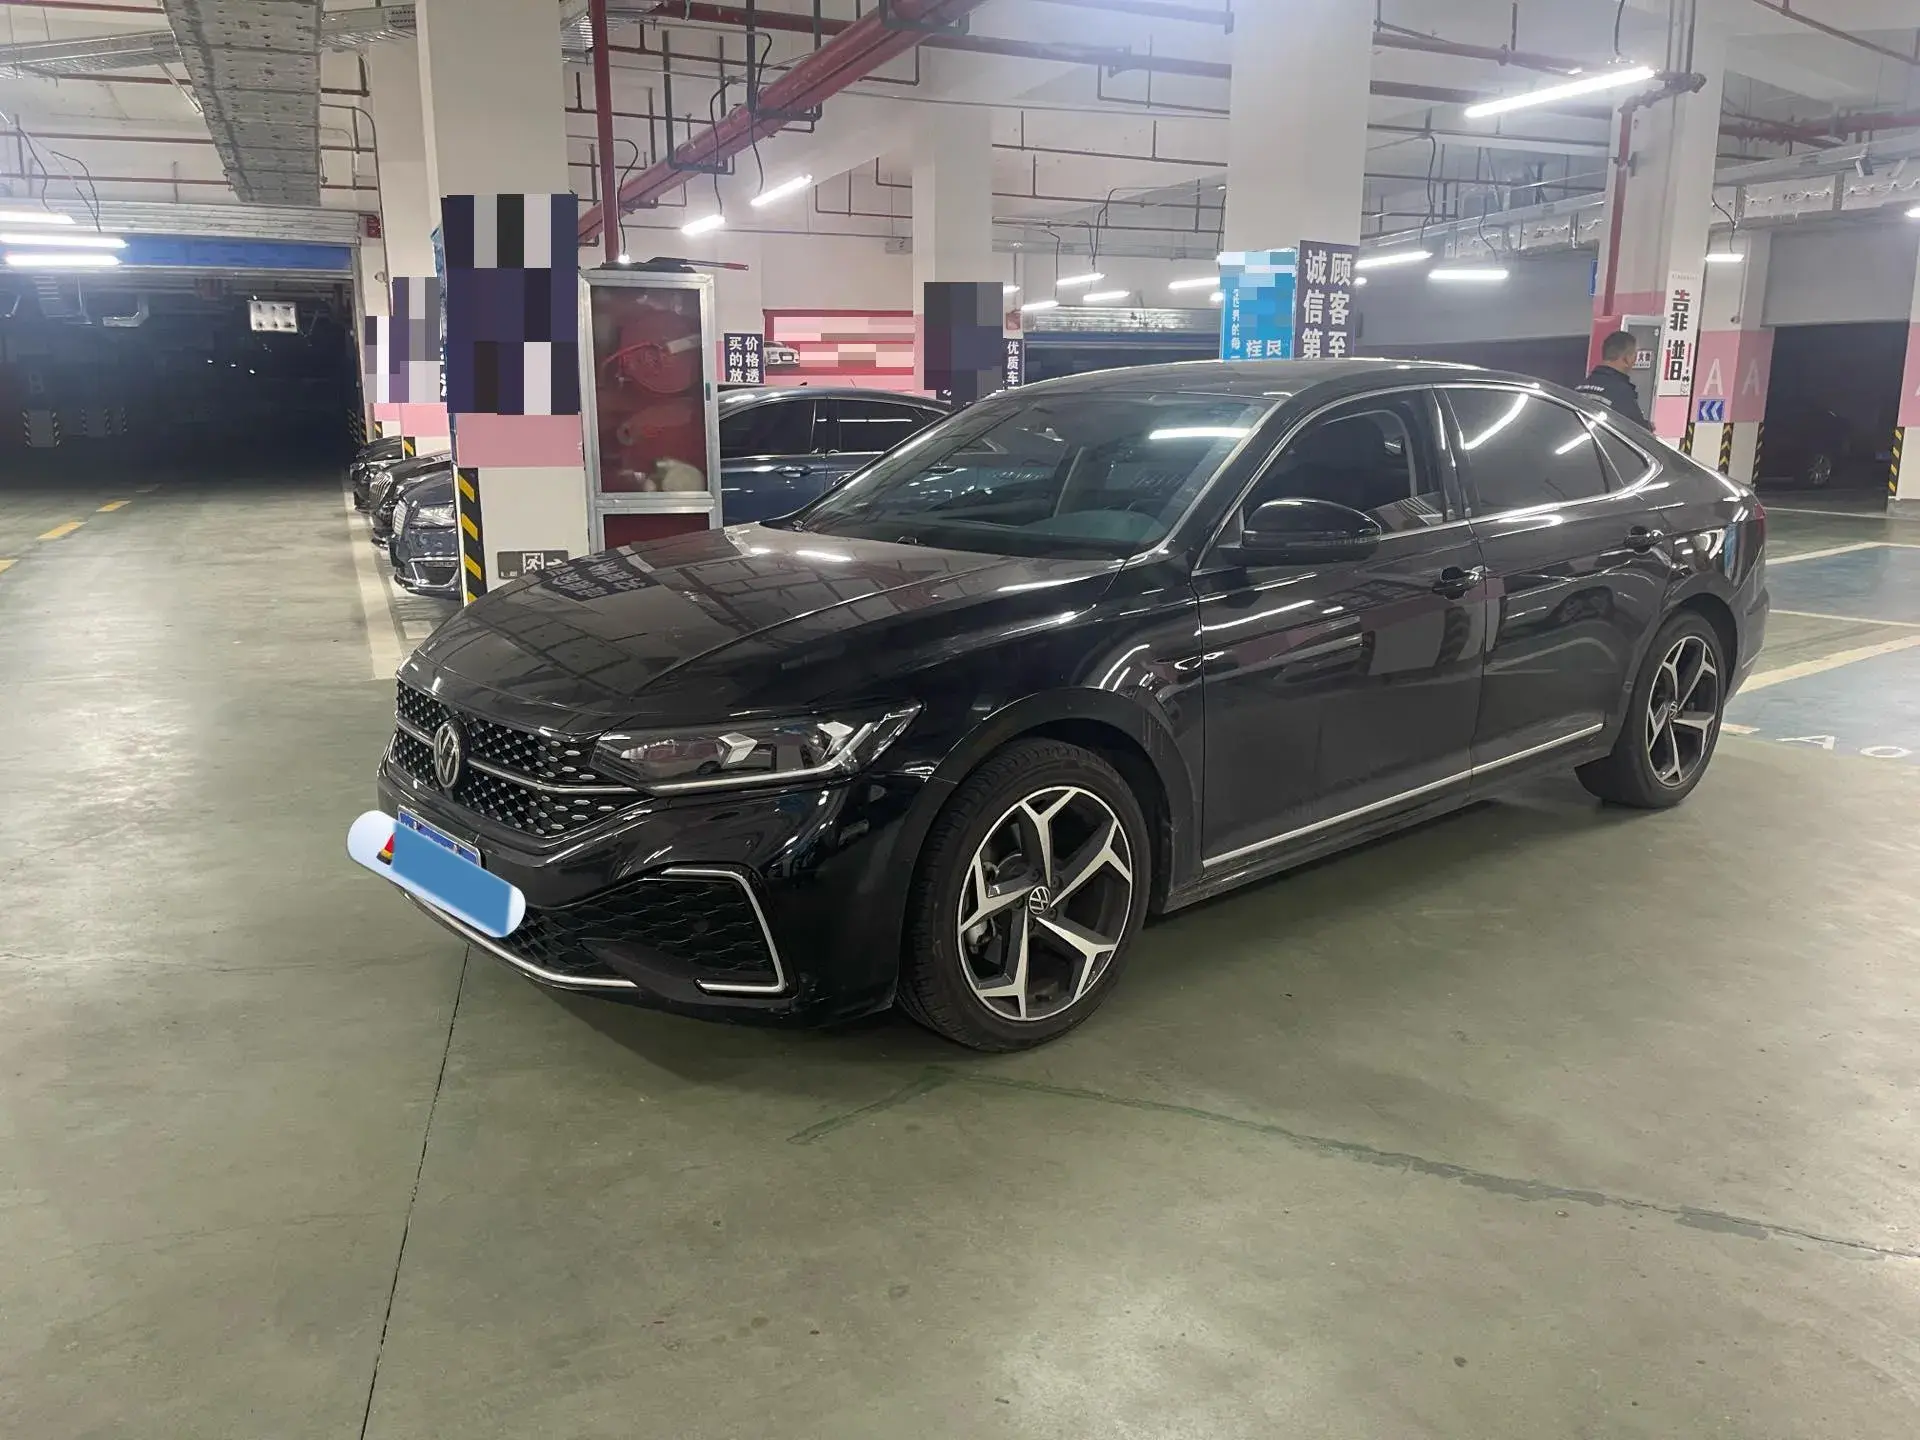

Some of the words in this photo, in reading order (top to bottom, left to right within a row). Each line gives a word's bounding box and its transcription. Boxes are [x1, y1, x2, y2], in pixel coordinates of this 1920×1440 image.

[1328, 253, 1353, 358] 顾客至
[729, 337, 743, 383] 买的放
[745, 337, 760, 383] 价格透
[1007, 341, 1019, 385] 优质车
[1703, 358, 1724, 396] A
[1742, 358, 1761, 396] A
